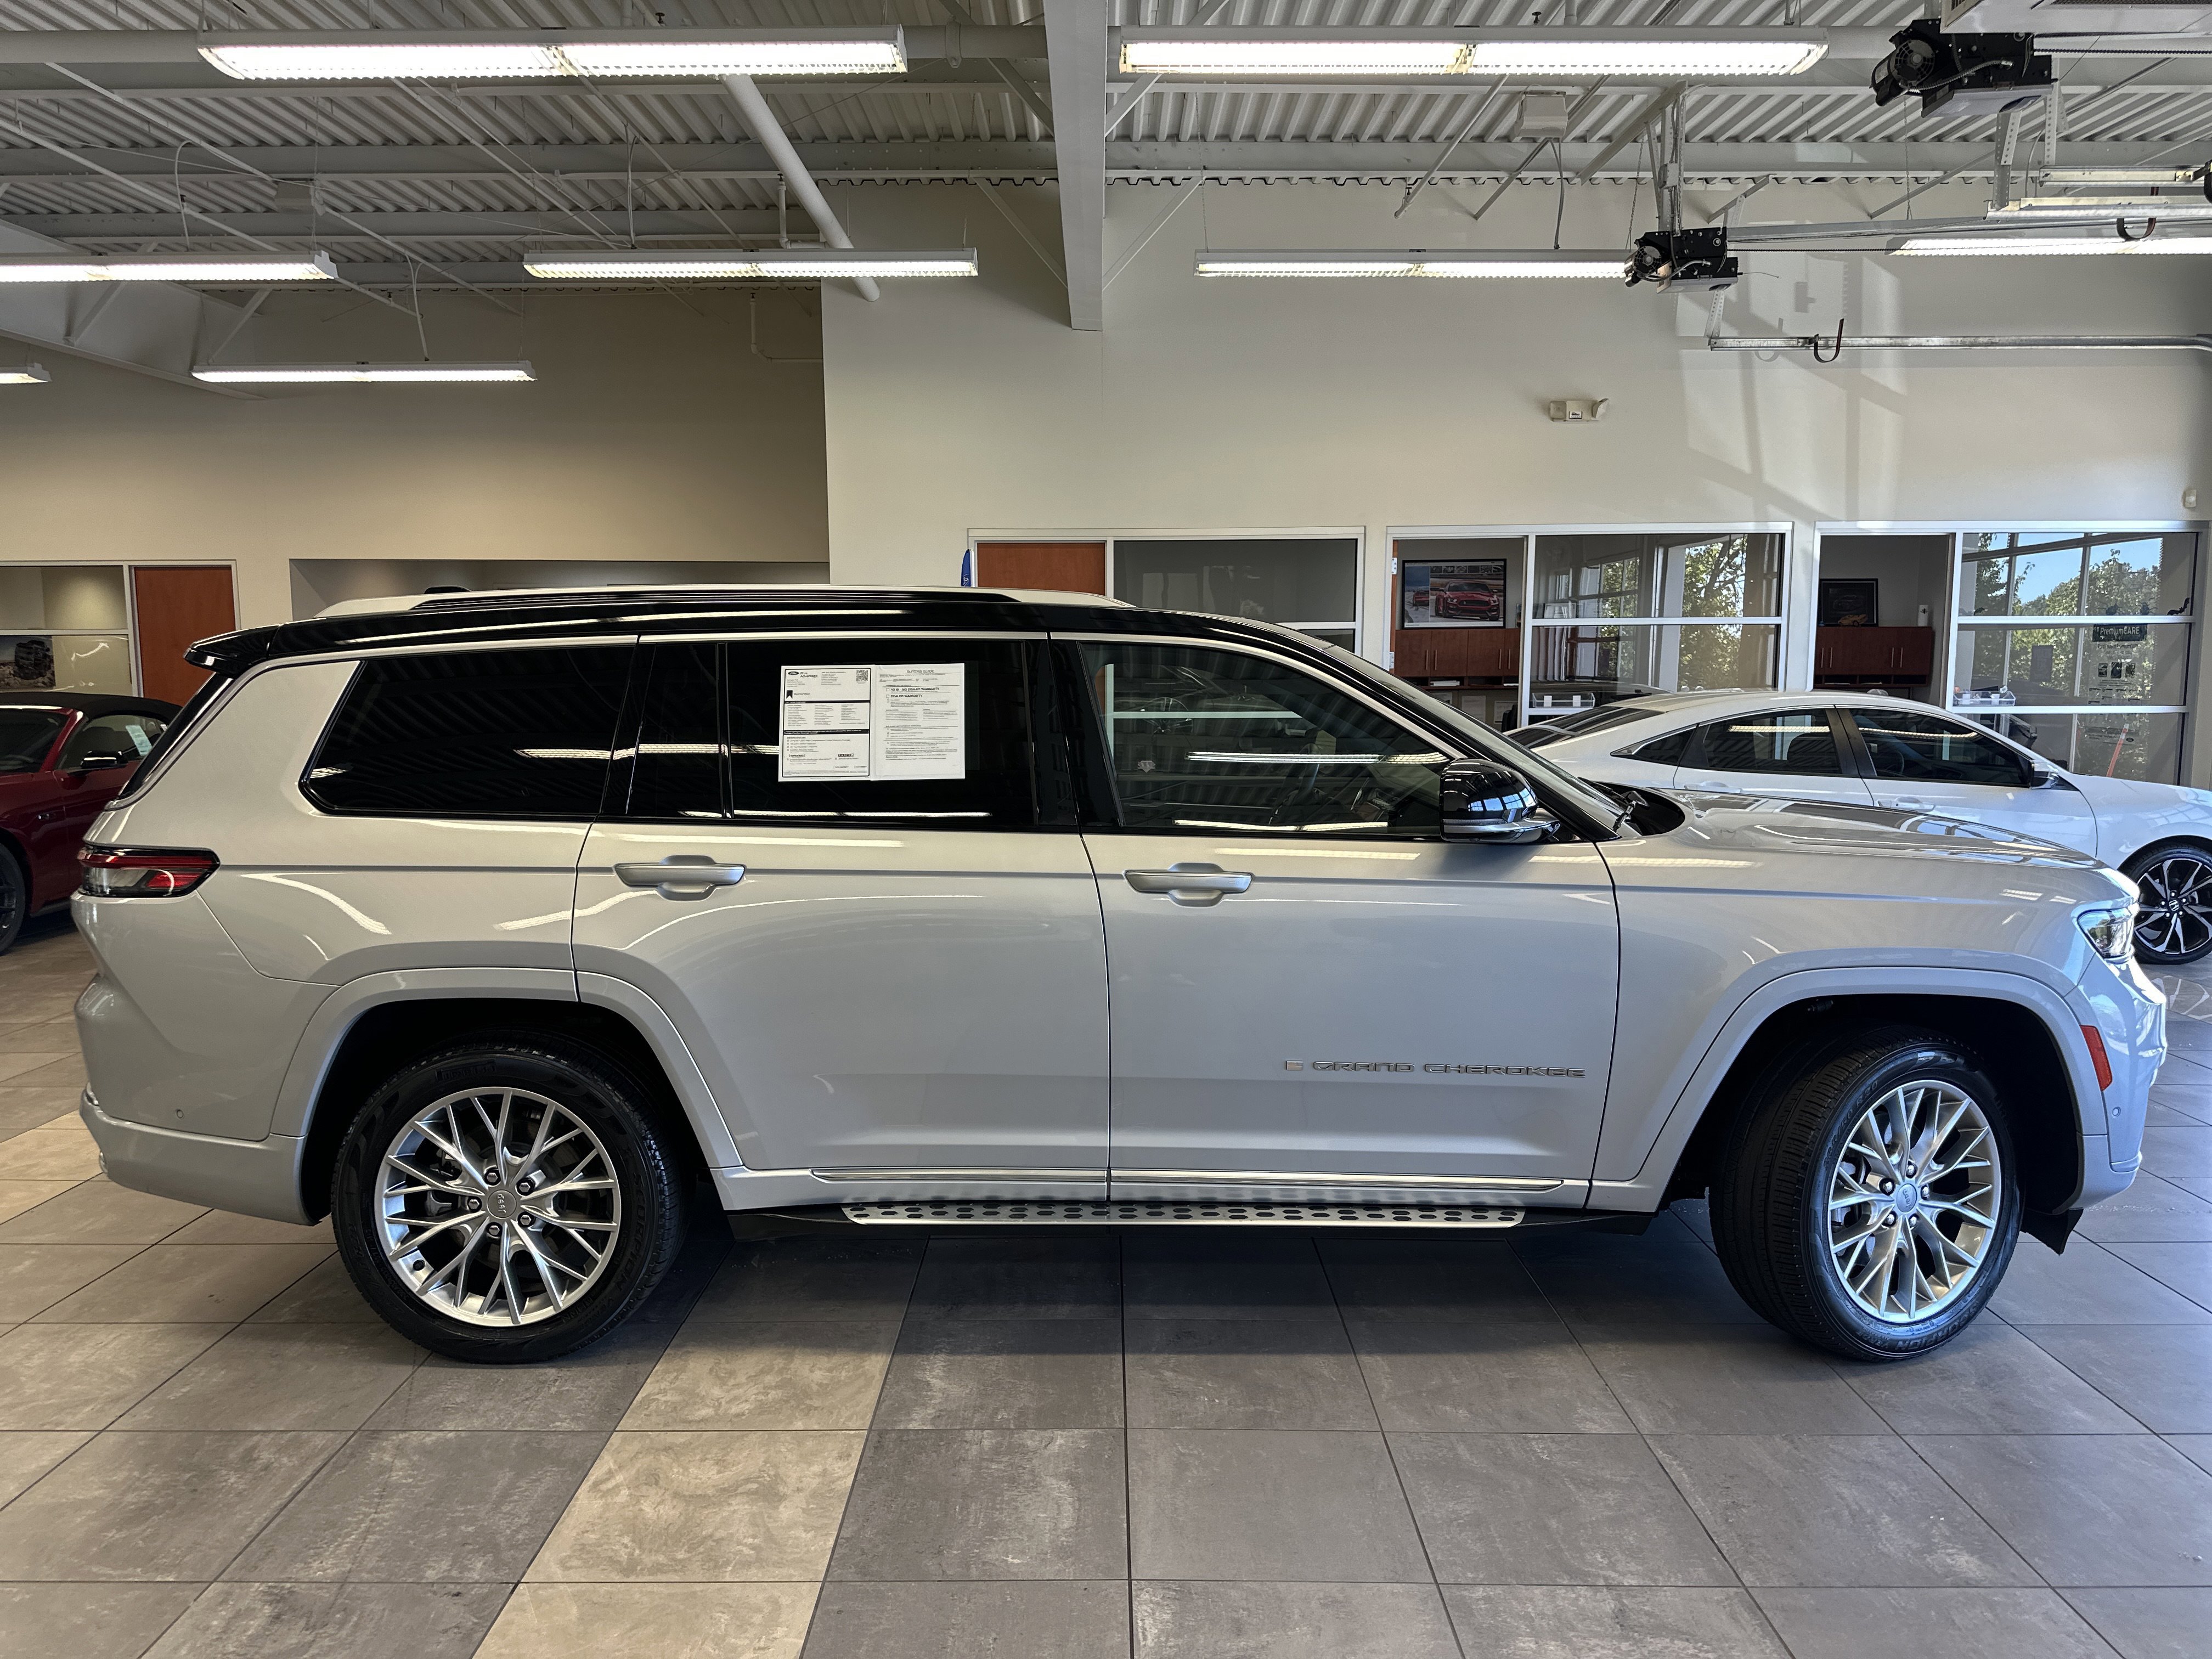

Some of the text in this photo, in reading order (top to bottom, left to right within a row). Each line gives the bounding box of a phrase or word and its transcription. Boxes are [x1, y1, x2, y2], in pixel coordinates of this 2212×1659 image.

[2100, 626, 2140, 635] PremiumCARE
[1313, 1060, 1586, 1078] GRAND CHEROKEE
[496, 1193, 507, 1214] Jeep
[615, 1172, 647, 1291] SCORPION
[1895, 1300, 1979, 1351] SCORPION
